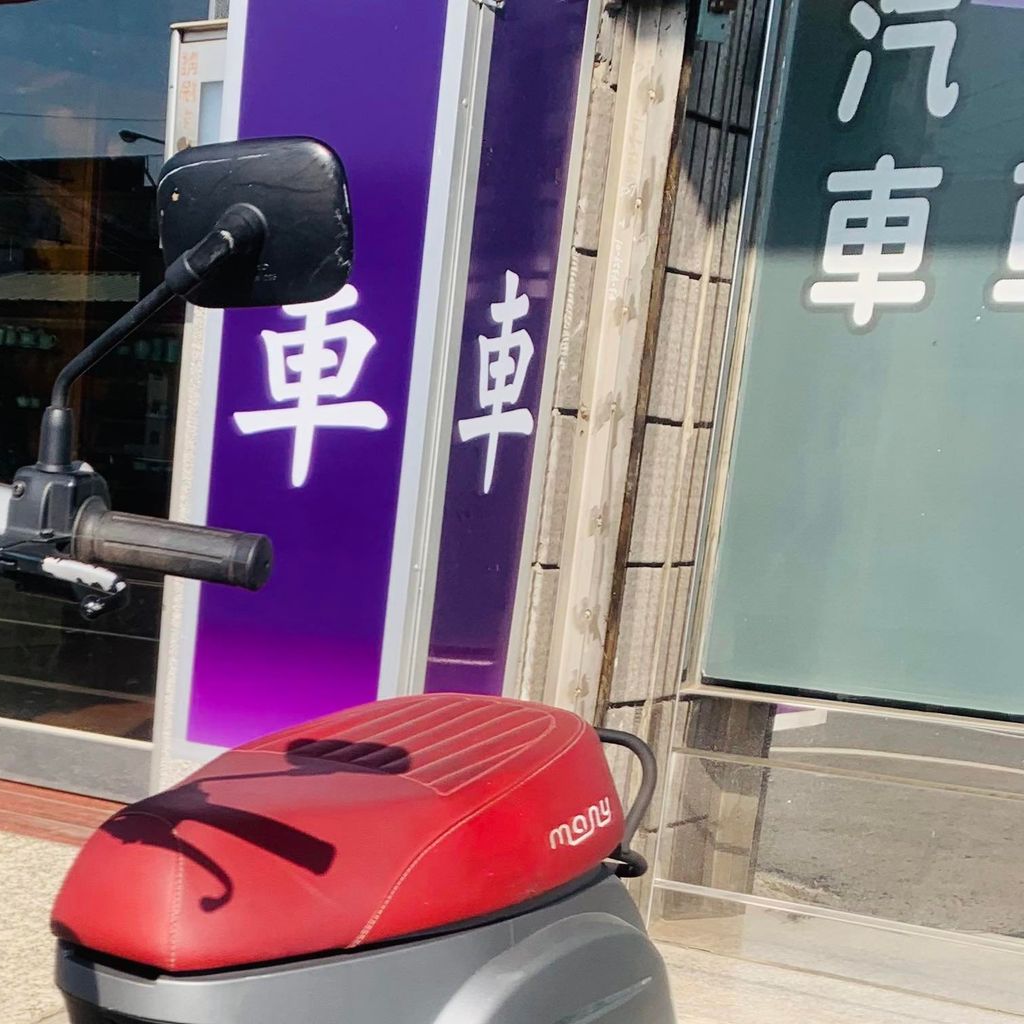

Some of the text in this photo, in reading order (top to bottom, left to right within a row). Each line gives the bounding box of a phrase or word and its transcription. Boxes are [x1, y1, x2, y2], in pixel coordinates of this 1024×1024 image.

[810, 0, 961, 326] 汽車
[233, 283, 389, 488] 車
[458, 269, 534, 494] 車
